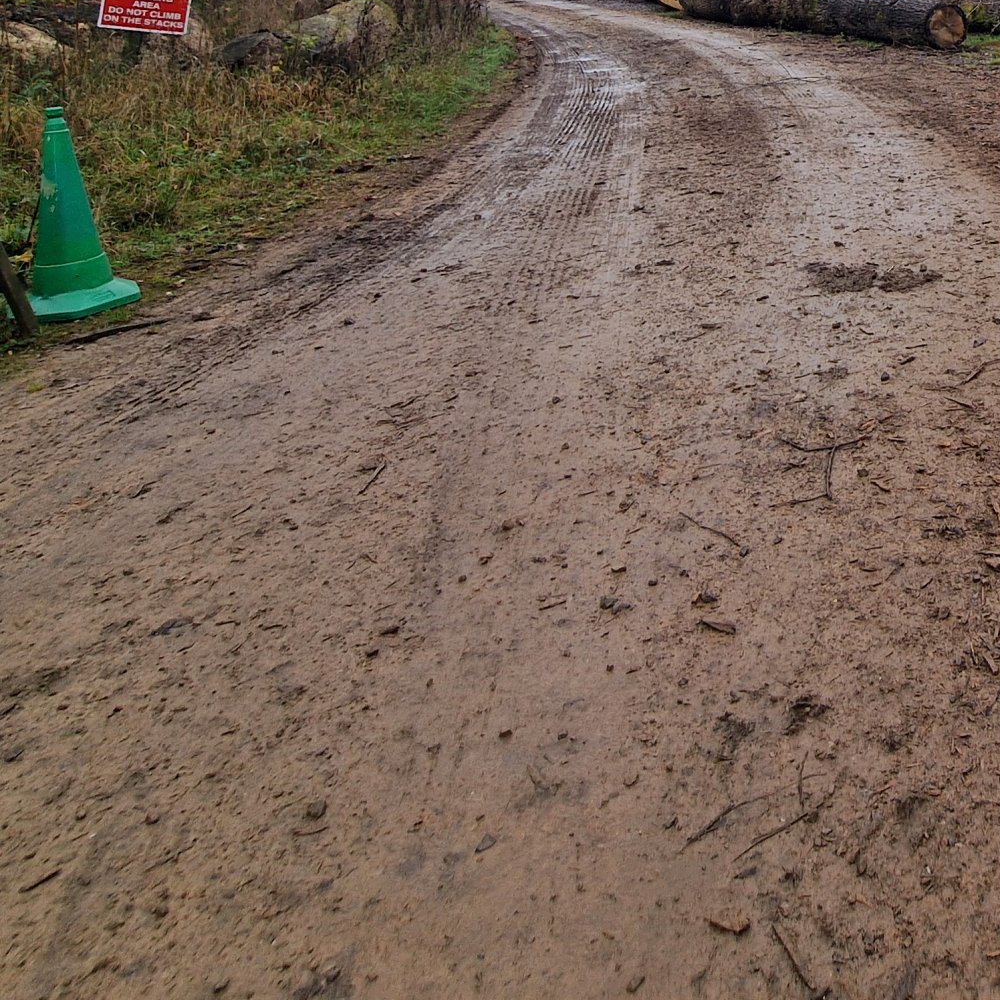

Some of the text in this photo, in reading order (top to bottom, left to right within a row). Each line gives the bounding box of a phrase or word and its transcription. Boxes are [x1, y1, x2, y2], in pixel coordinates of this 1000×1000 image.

[132, 0, 160, 10] AREA
[108, 6, 182, 20] DO NOT CLIMB
[103, 14, 184, 29] ON THE STACKS
